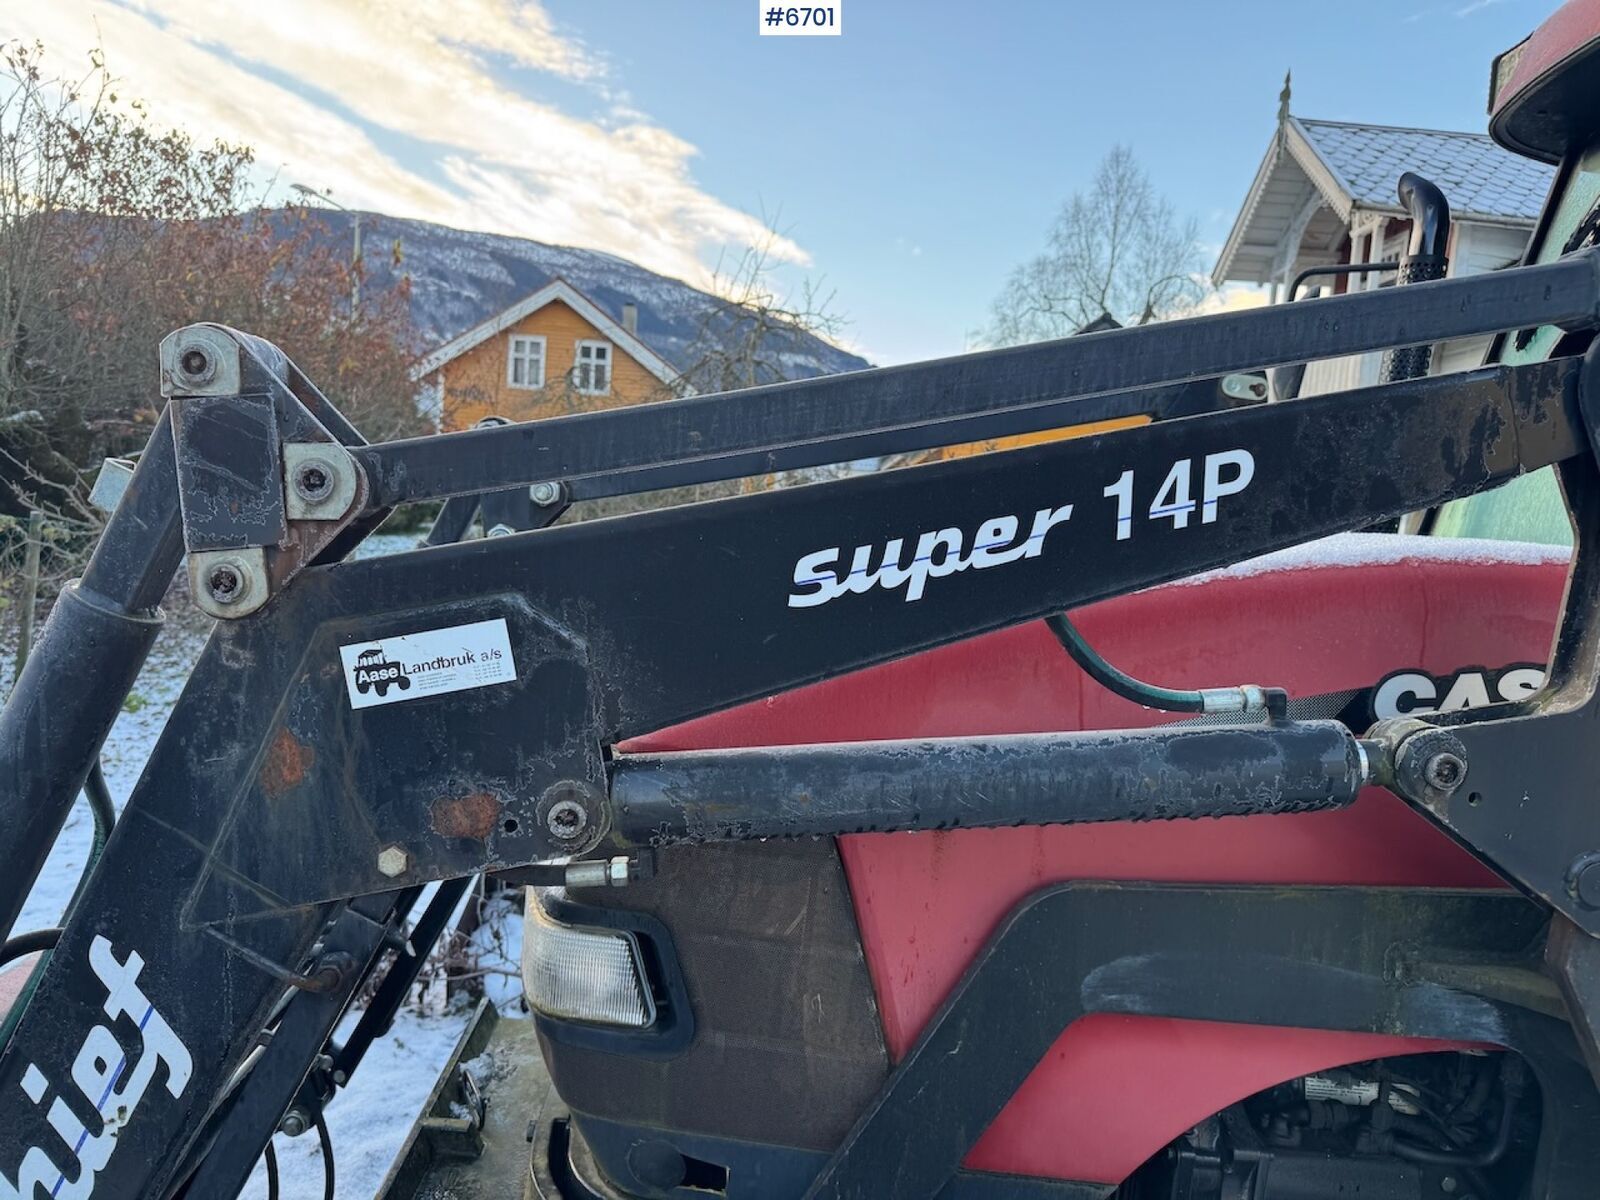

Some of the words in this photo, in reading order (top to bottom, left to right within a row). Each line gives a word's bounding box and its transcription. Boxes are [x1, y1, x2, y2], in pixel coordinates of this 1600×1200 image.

[788, 504, 1074, 607] super
[1104, 448, 1255, 540] 14P
[357, 666, 399, 685] Aase
[402, 651, 476, 675] Landbruk
[480, 648, 503, 662] a/s
